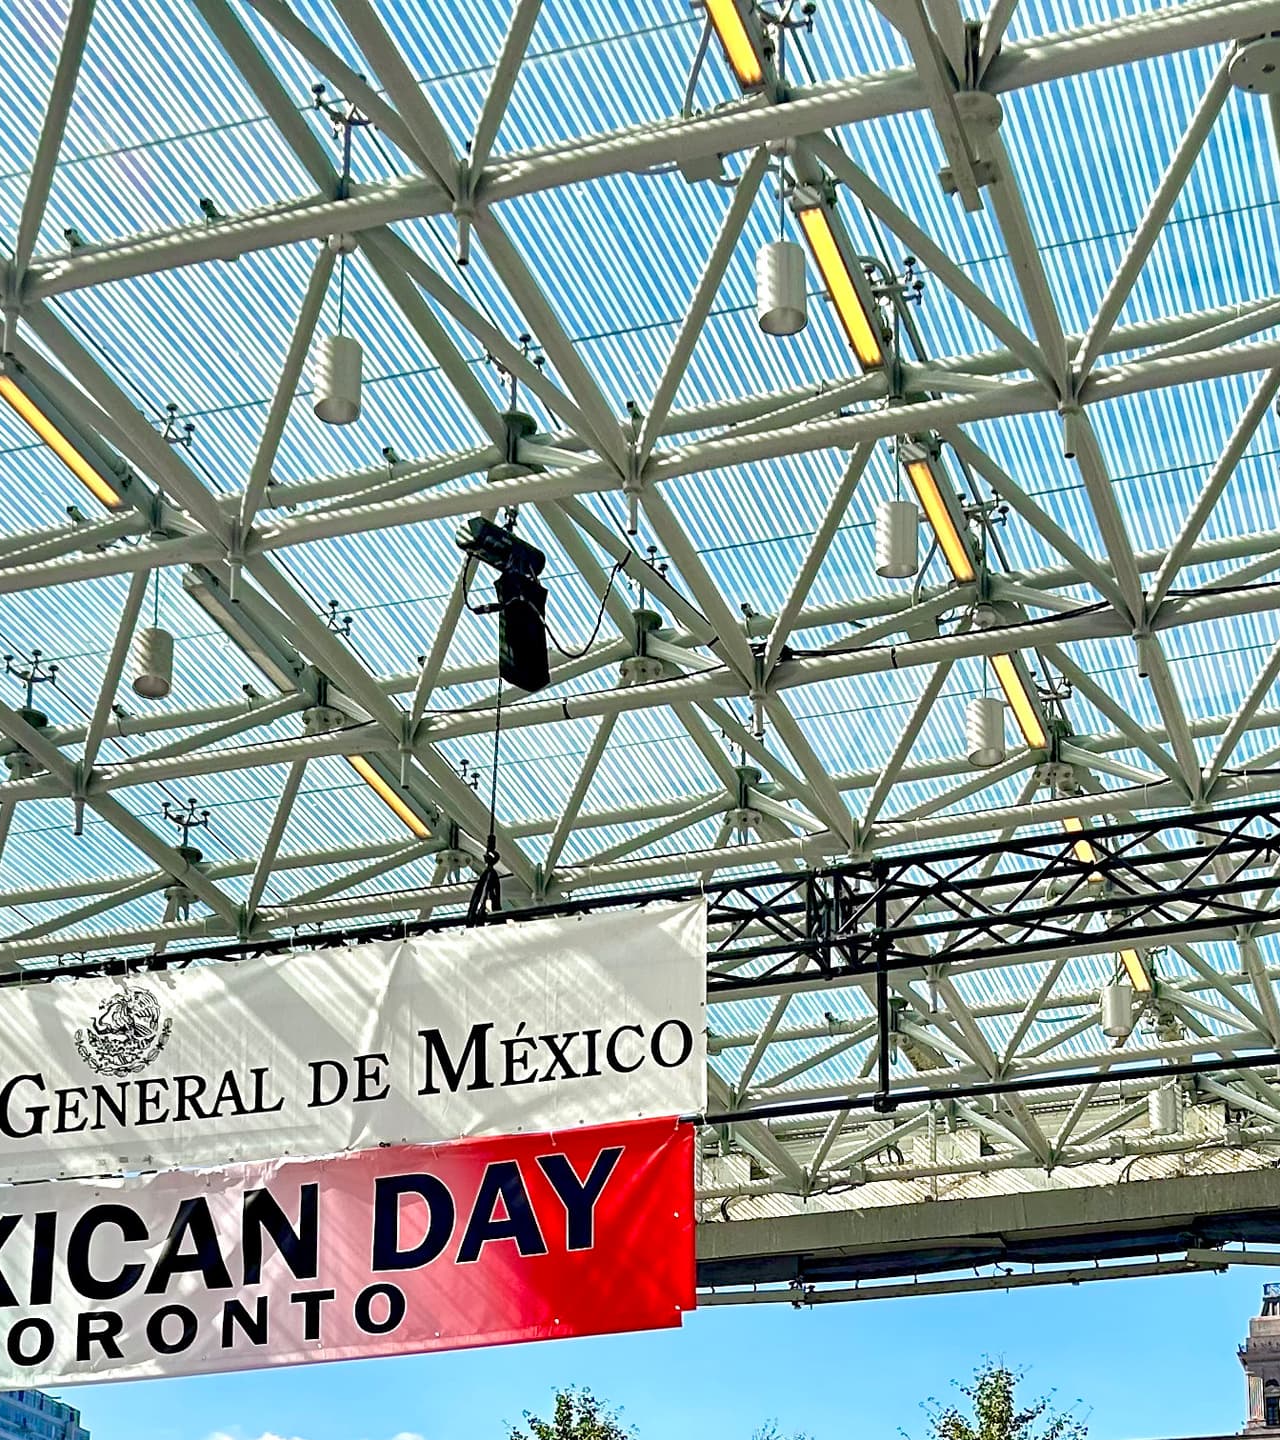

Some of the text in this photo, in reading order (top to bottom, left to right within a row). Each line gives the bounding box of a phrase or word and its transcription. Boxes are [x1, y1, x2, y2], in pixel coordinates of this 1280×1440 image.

[306, 1052, 391, 1108] DE
[417, 1020, 694, 1097] MÉXICO
[371, 1145, 626, 1272] DAY
